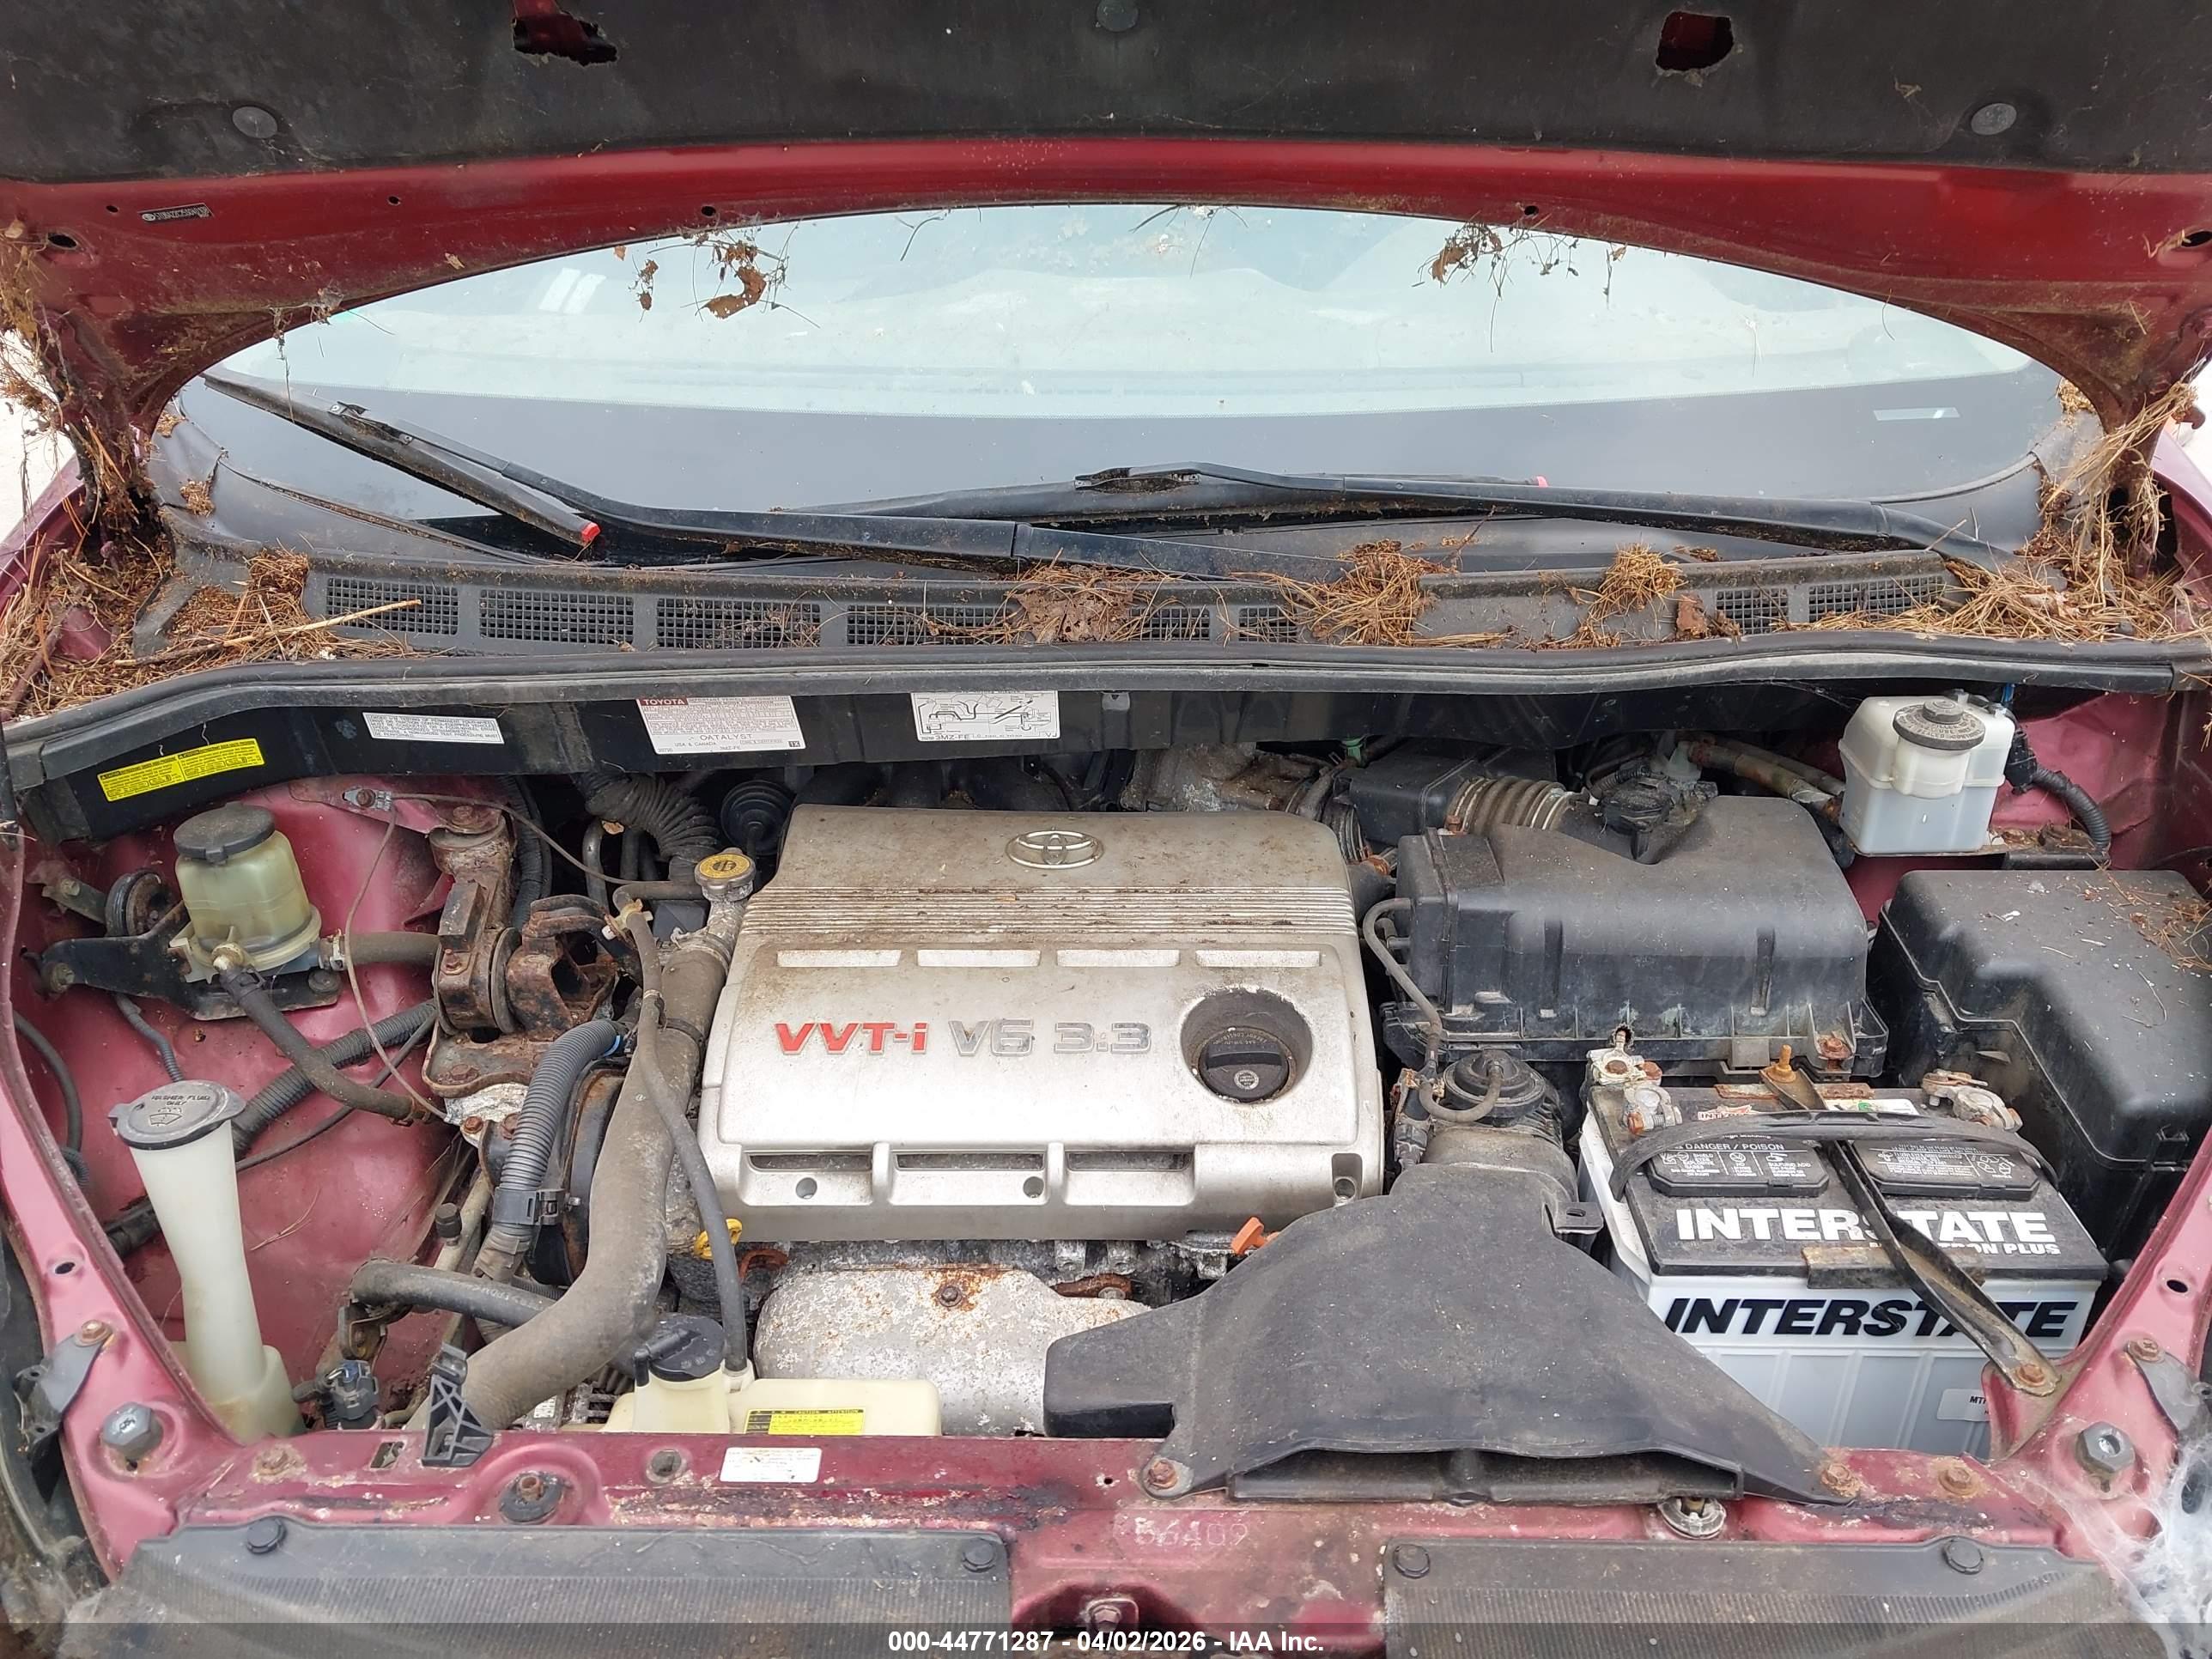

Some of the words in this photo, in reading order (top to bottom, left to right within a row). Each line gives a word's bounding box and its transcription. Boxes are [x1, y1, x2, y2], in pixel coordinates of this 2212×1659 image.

[775, 1021, 927, 1054] VVT-i
[947, 1018, 1035, 1057] V6
[1054, 1021, 1152, 1054] 3.3
[2002, 1243, 2062, 1255] PLUS
[1664, 1297, 2079, 1338] INTERSTTE
